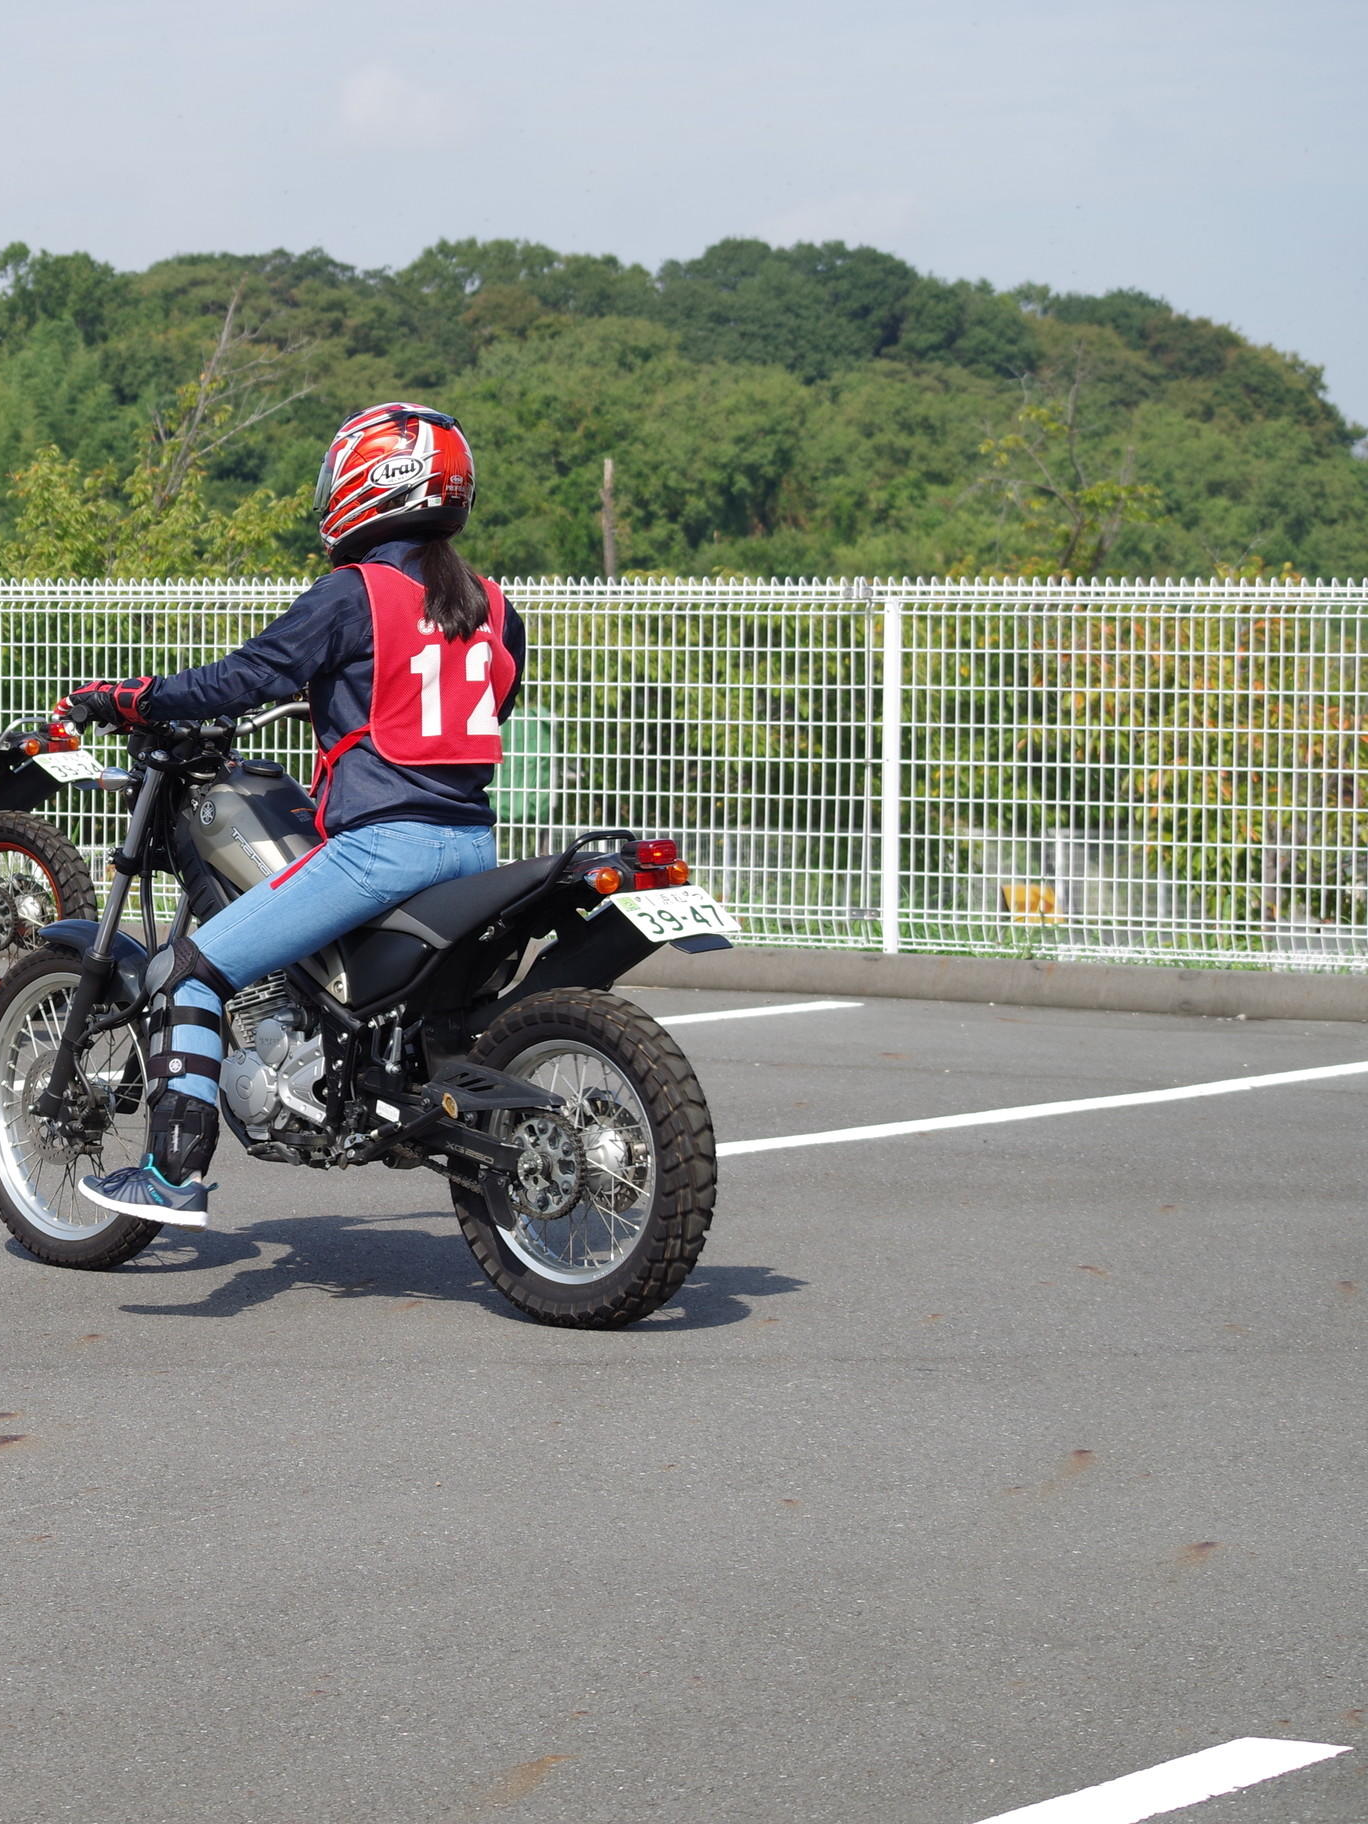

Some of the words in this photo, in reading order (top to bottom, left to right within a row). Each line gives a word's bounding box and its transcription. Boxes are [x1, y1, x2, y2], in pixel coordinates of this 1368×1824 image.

[374, 459, 416, 482] Arai
[410, 641, 501, 737] 12
[637, 904, 725, 935] 39-47
